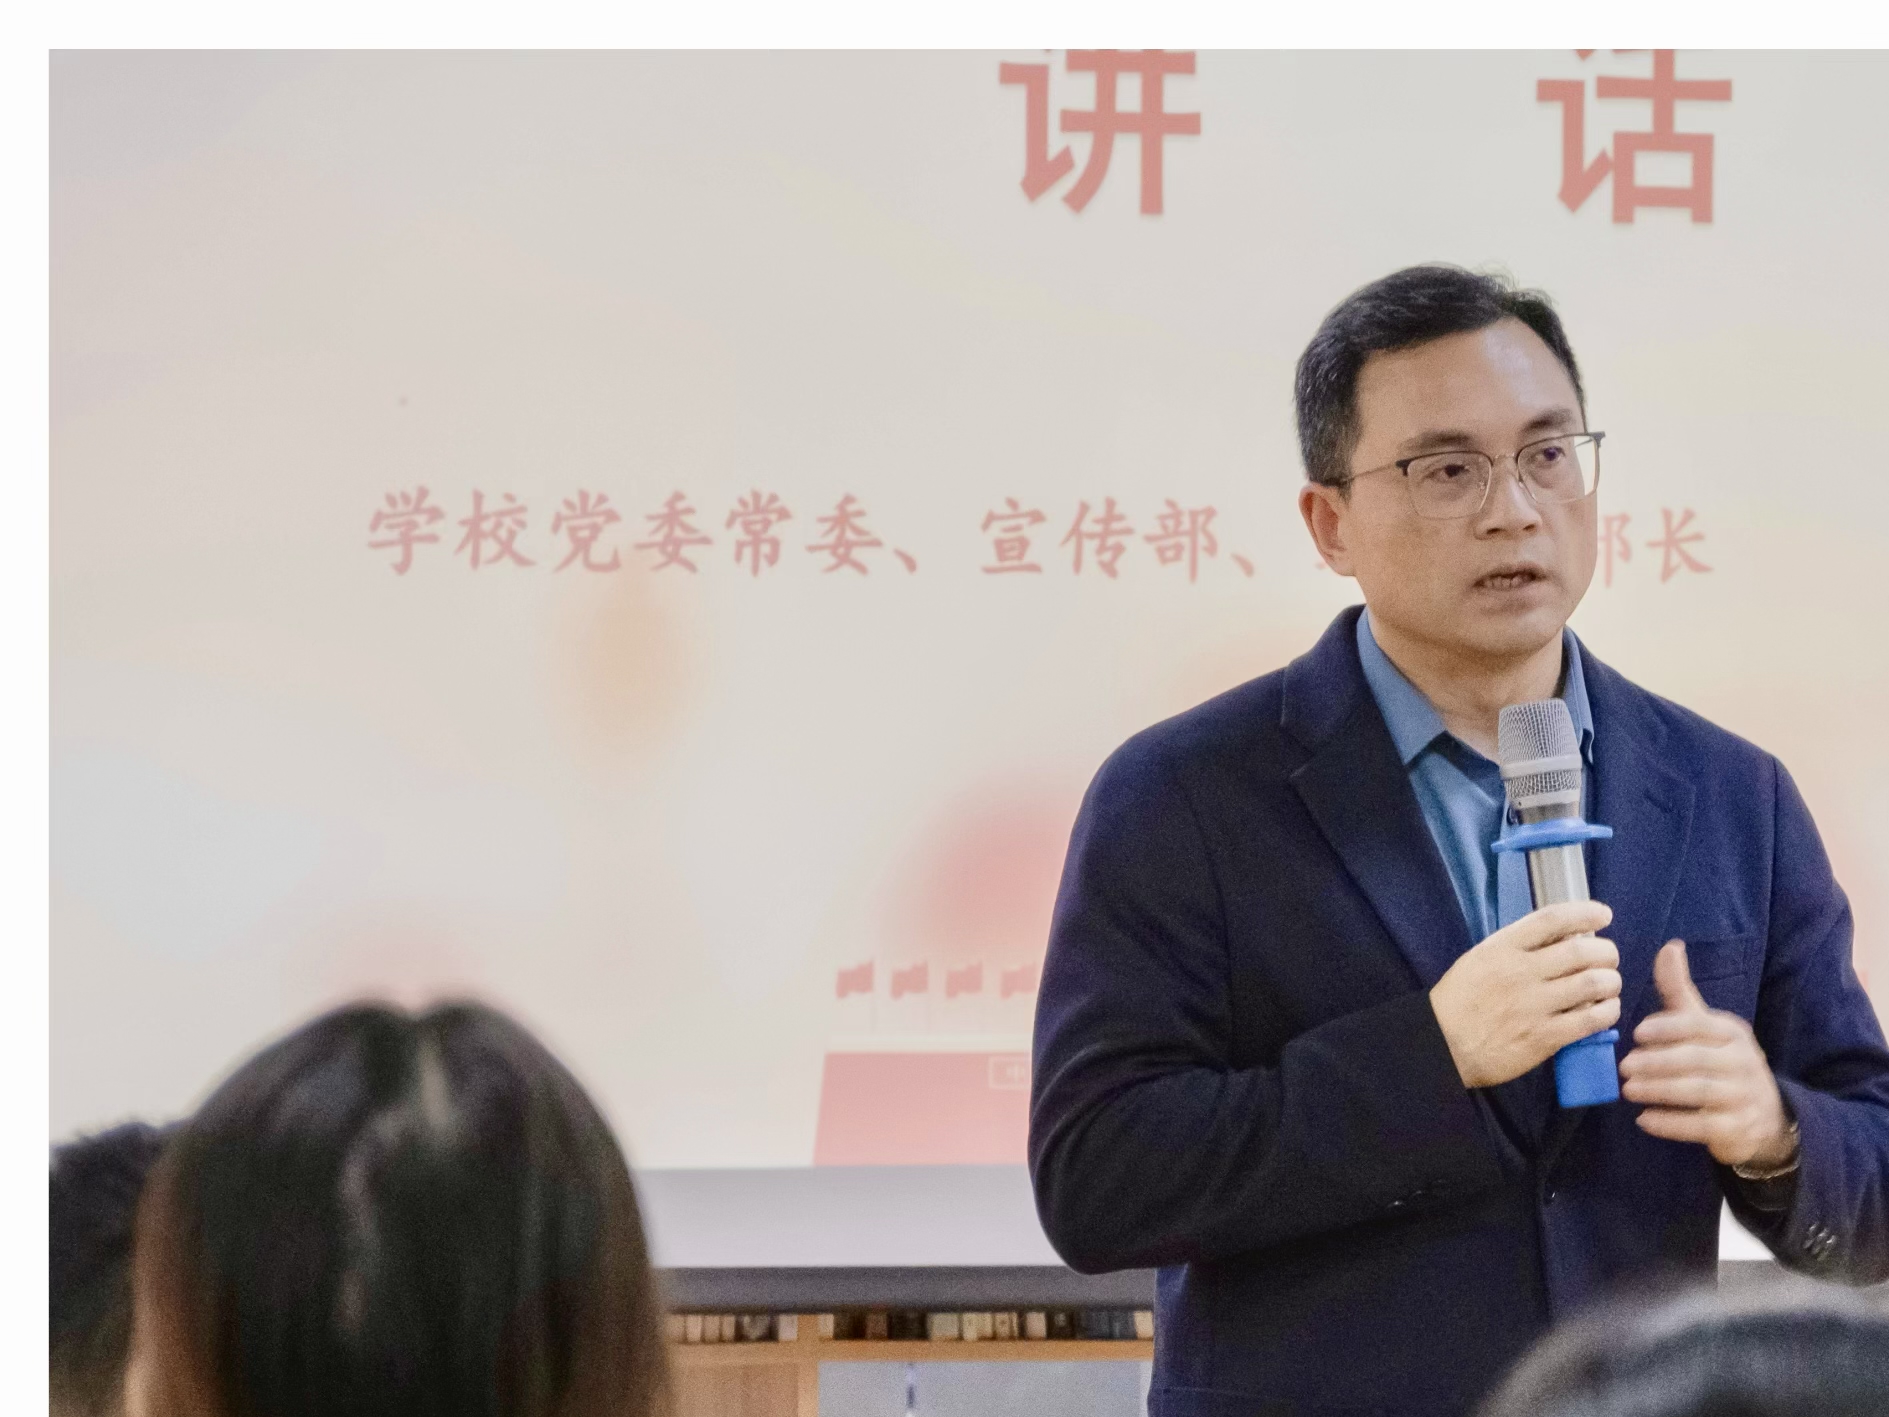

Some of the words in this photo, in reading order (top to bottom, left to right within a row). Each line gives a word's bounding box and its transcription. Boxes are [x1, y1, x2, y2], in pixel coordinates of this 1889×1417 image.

[1000, 49, 1733, 225] 讲话
[367, 484, 1256, 584] 学校党委常委、宣传部、
